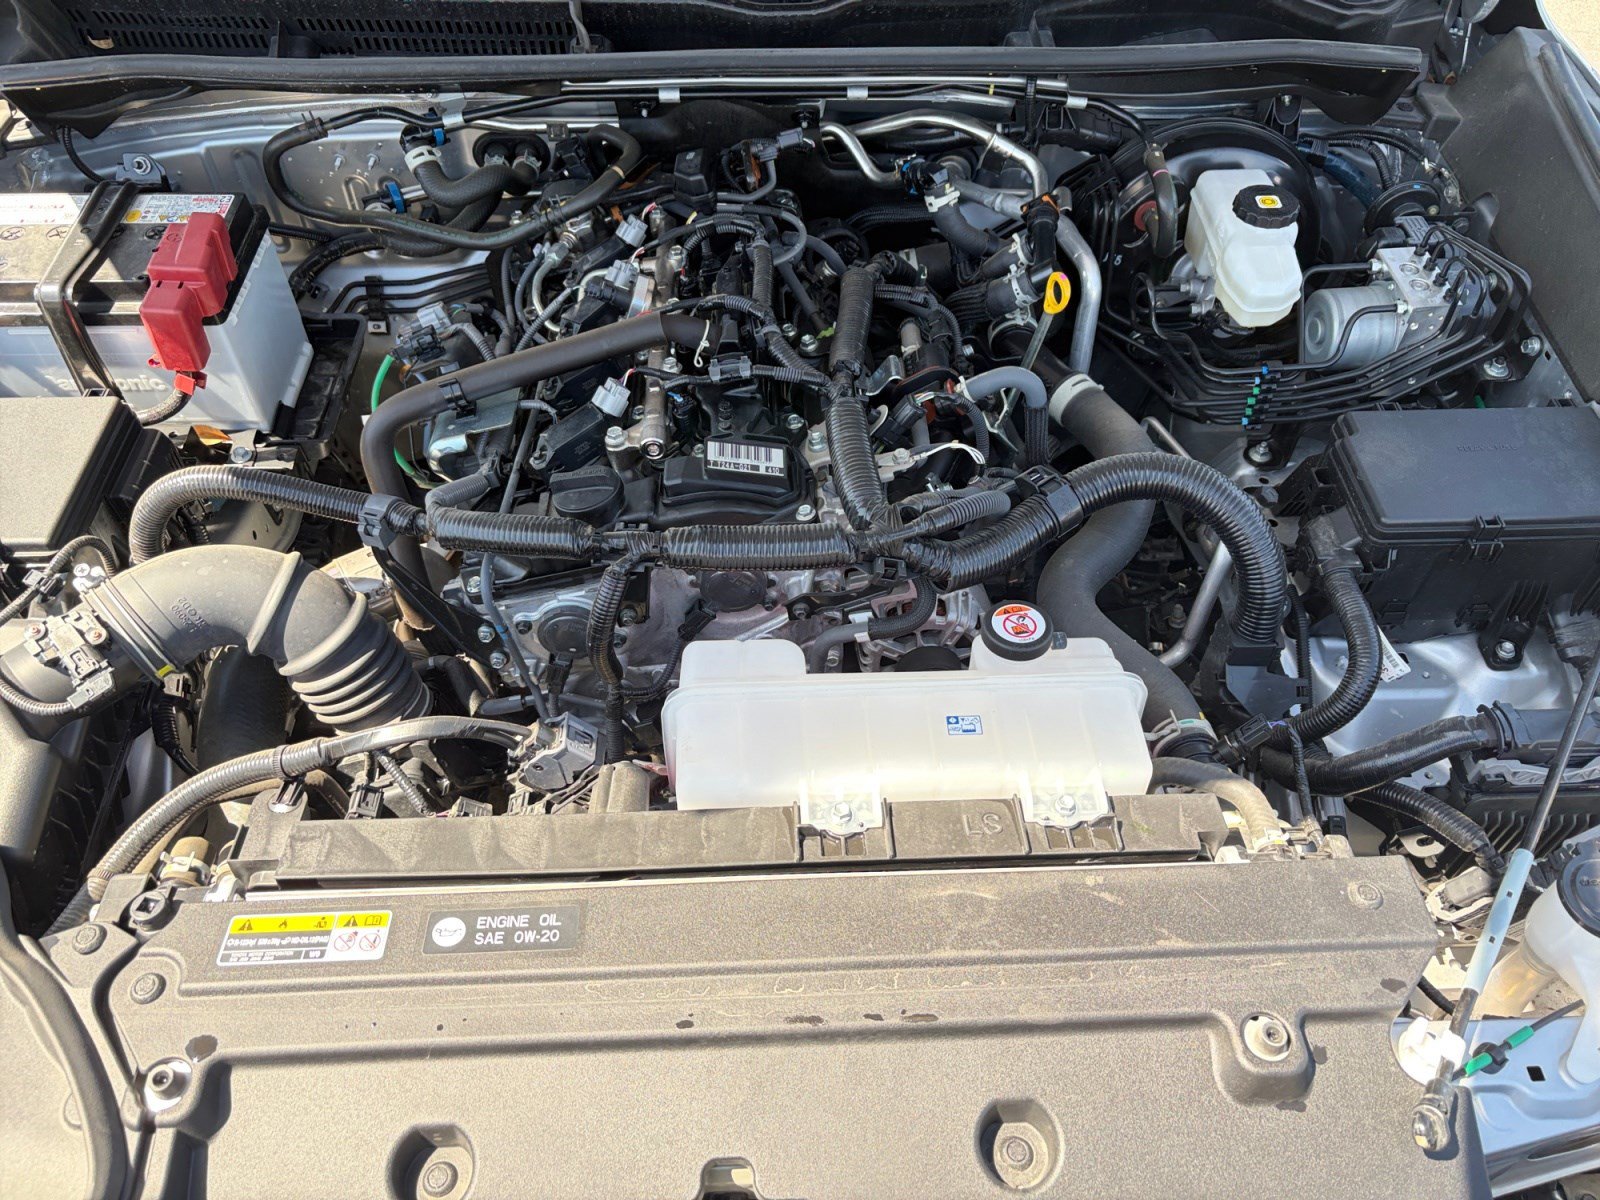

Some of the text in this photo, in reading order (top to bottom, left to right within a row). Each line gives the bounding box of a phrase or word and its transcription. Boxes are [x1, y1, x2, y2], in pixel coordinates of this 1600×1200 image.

[962, 811, 1003, 836] LS
[476, 913, 562, 929] ENGINE OIL
[474, 929, 560, 945] SAE 0W-20
